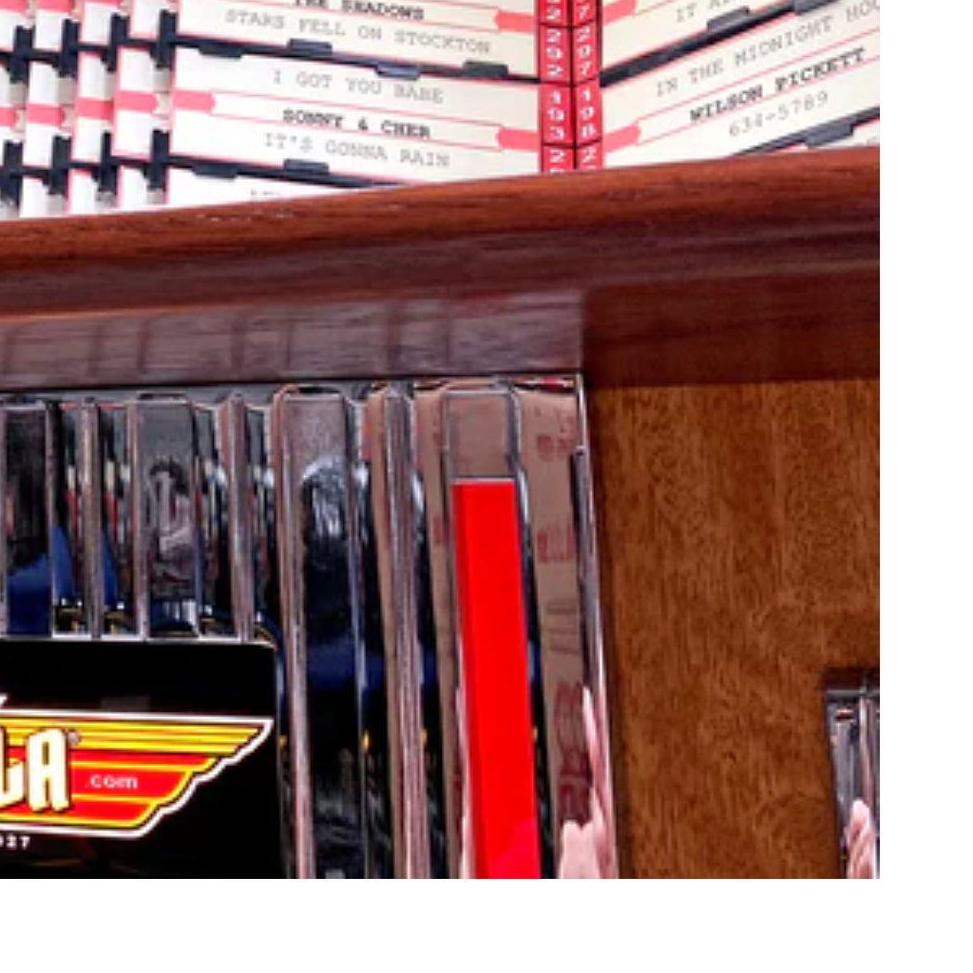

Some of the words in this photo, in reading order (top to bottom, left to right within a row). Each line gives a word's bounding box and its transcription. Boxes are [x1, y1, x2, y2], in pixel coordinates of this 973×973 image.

[224, 8, 286, 30] STARS
[298, 16, 347, 37] FELL
[357, 24, 383, 41] ON
[394, 30, 493, 55] STOCKTON
[676, 6, 696, 23] IT
[656, 79, 679, 97] IN
[687, 59, 725, 85] THE
[734, 16, 835, 67] MIDNIGHT
[273, 70, 282, 84] I
[295, 71, 333, 89] GOT
[344, 77, 383, 96] YOU
[394, 83, 445, 105] BABE
[689, 84, 764, 123] WILSON
[774, 47, 866, 94] PICKETT
[282, 108, 346, 130] SONNY
[381, 120, 432, 139] CHER
[728, 90, 830, 138] 634-5789
[263, 132, 314, 152] IT'S
[325, 139, 390, 163] GONNA
[399, 148, 451, 169] RAIN
[84, 773, 139, 790] .com
